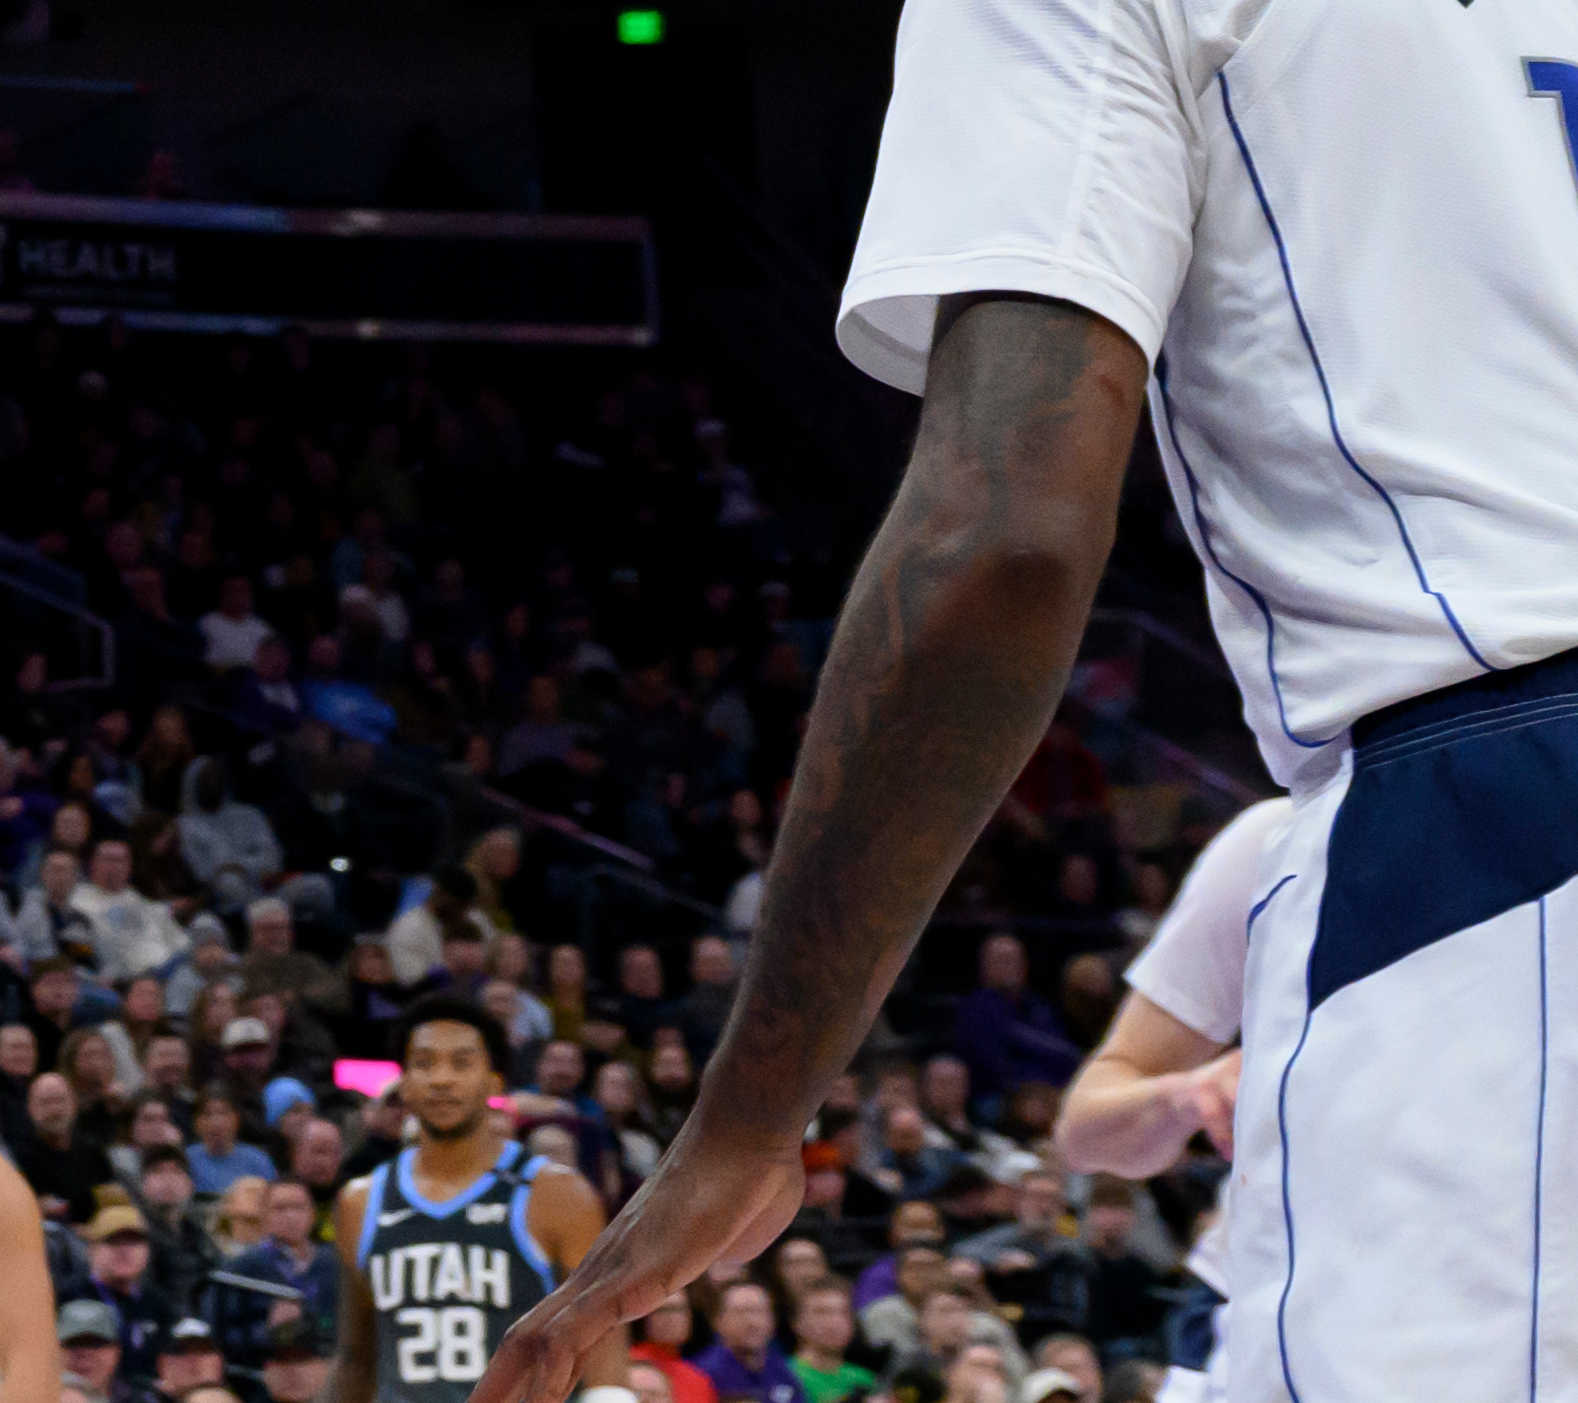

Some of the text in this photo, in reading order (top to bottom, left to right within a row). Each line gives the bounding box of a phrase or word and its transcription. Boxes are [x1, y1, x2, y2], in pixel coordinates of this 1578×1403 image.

[18, 238, 178, 284] HEALTH
[369, 1243, 511, 1312] UTAH
[395, 1307, 489, 1384] 28
